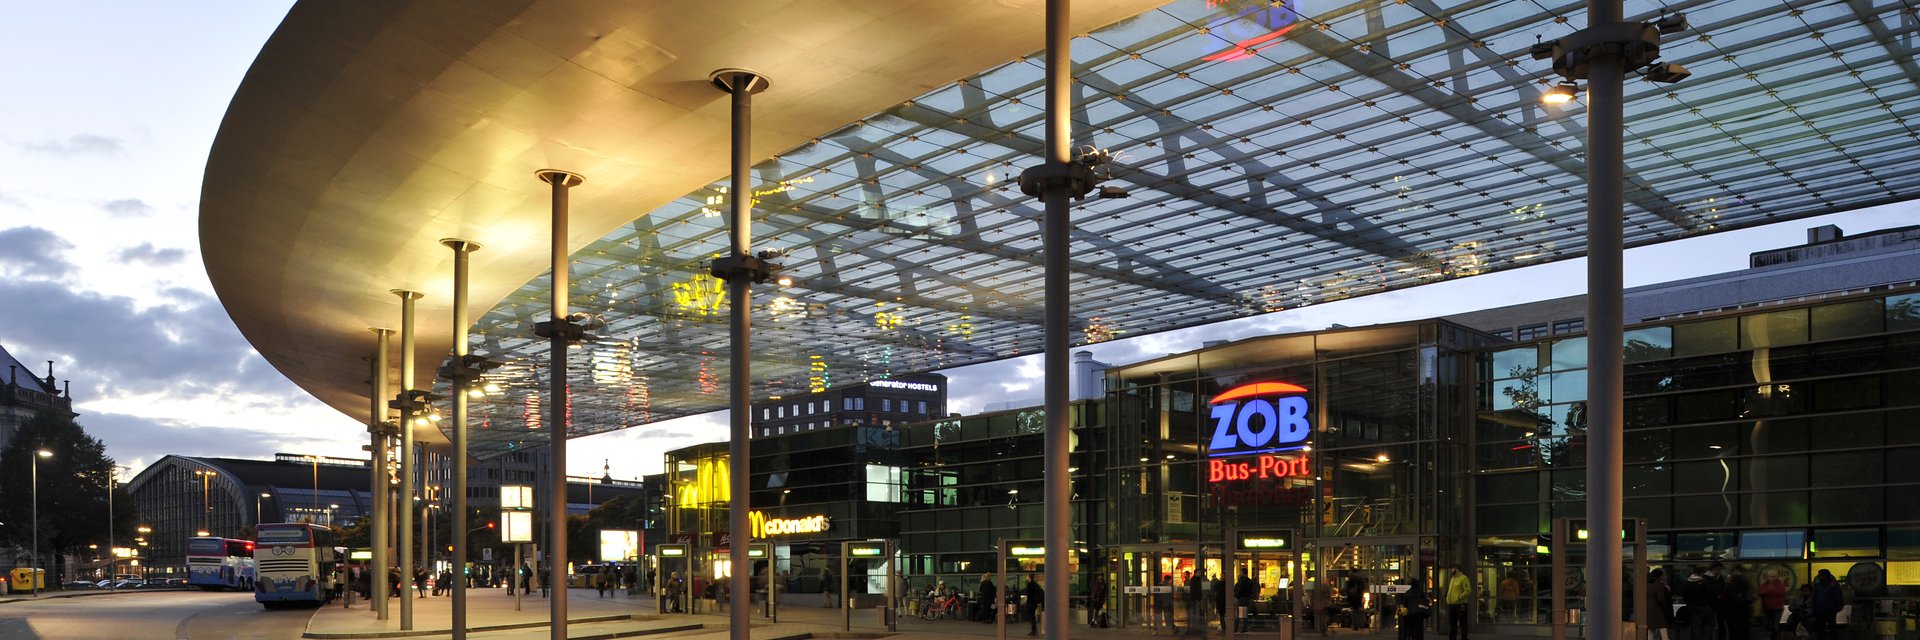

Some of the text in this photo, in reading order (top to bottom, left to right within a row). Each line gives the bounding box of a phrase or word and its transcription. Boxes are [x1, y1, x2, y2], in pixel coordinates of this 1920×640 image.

[907, 383, 938, 392] HOSTELS
[1209, 396, 1310, 450] ZOB
[1209, 454, 1310, 482] Bus-Port
[748, 510, 830, 539] McDonald's
